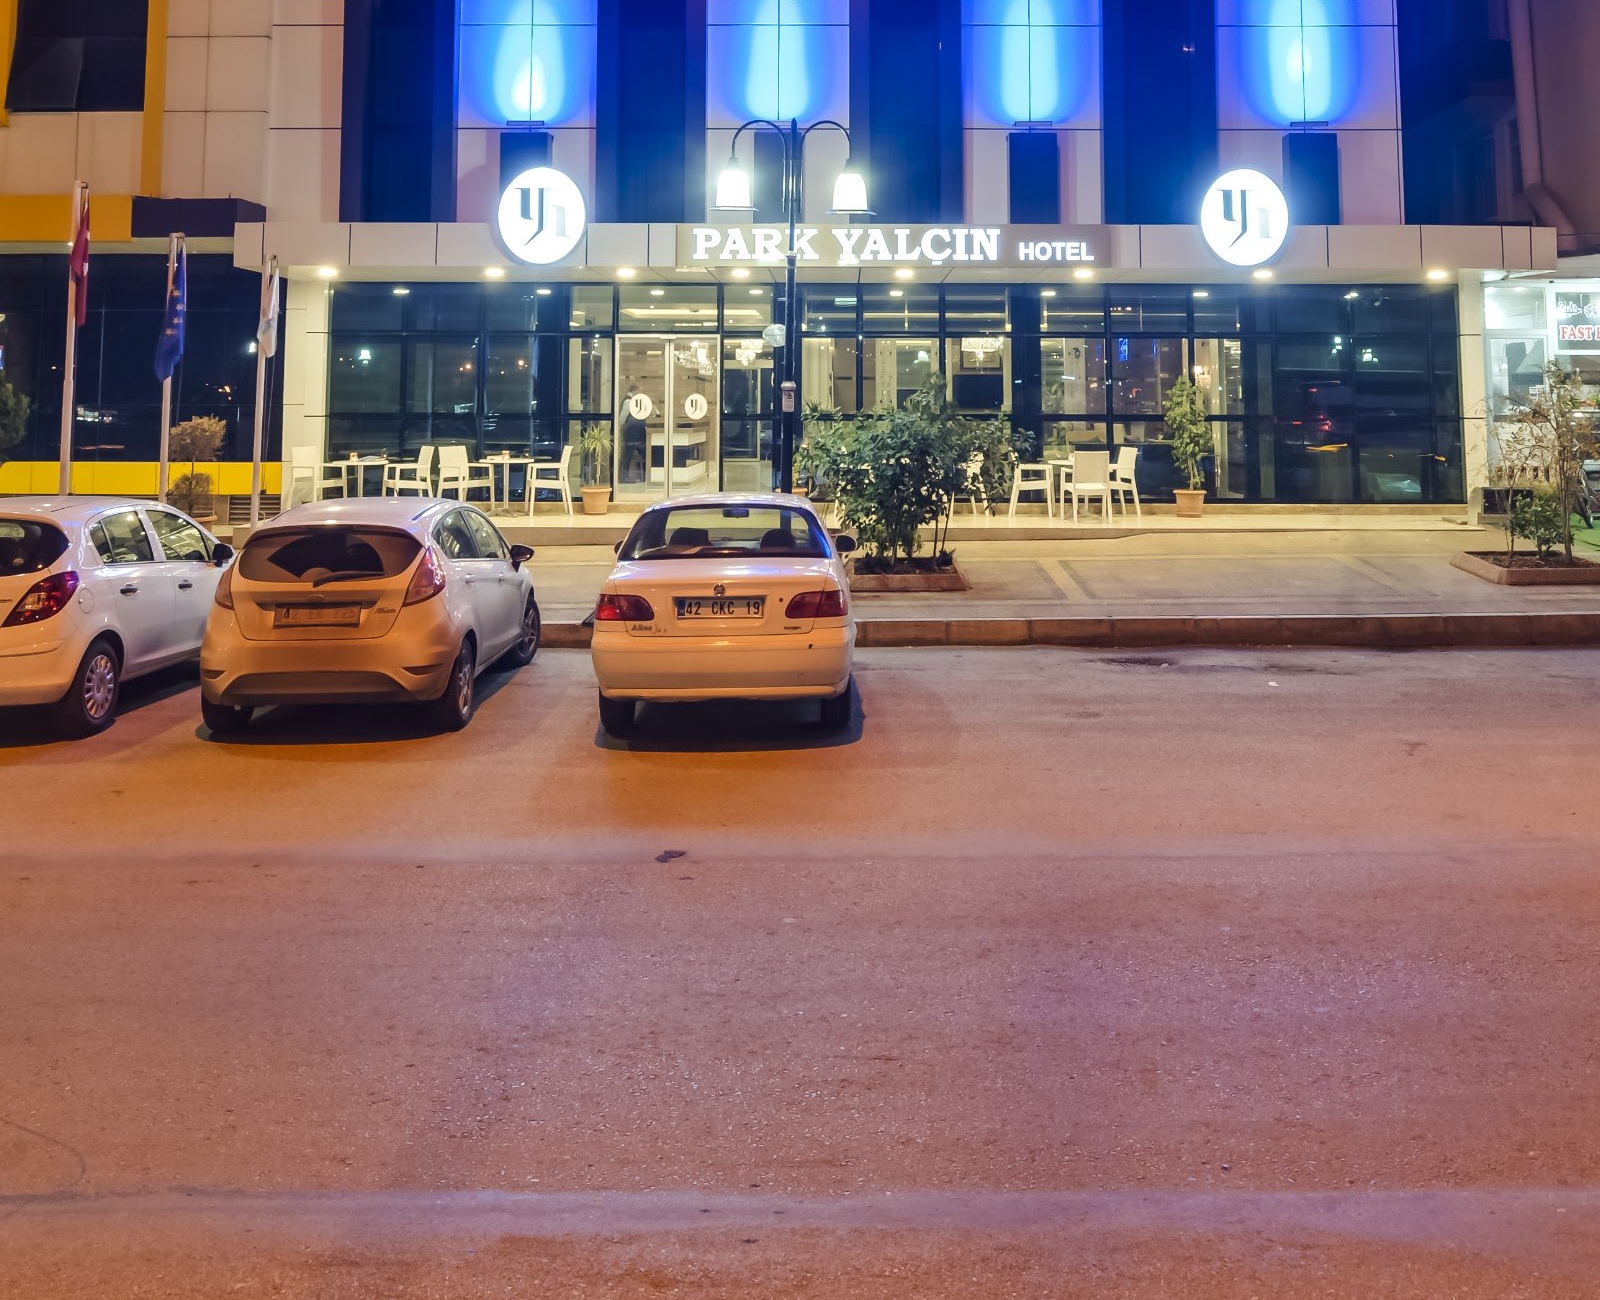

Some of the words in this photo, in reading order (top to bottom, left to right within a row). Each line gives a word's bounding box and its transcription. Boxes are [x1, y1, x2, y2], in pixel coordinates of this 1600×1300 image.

[692, 228, 819, 260] PARK
[831, 228, 1001, 266] YALÇIN
[1019, 242, 1095, 261] HOTEL
[1560, 325, 1593, 340] FAST
[686, 601, 701, 615] 42
[711, 601, 735, 615] CKC
[746, 601, 760, 615] 19
